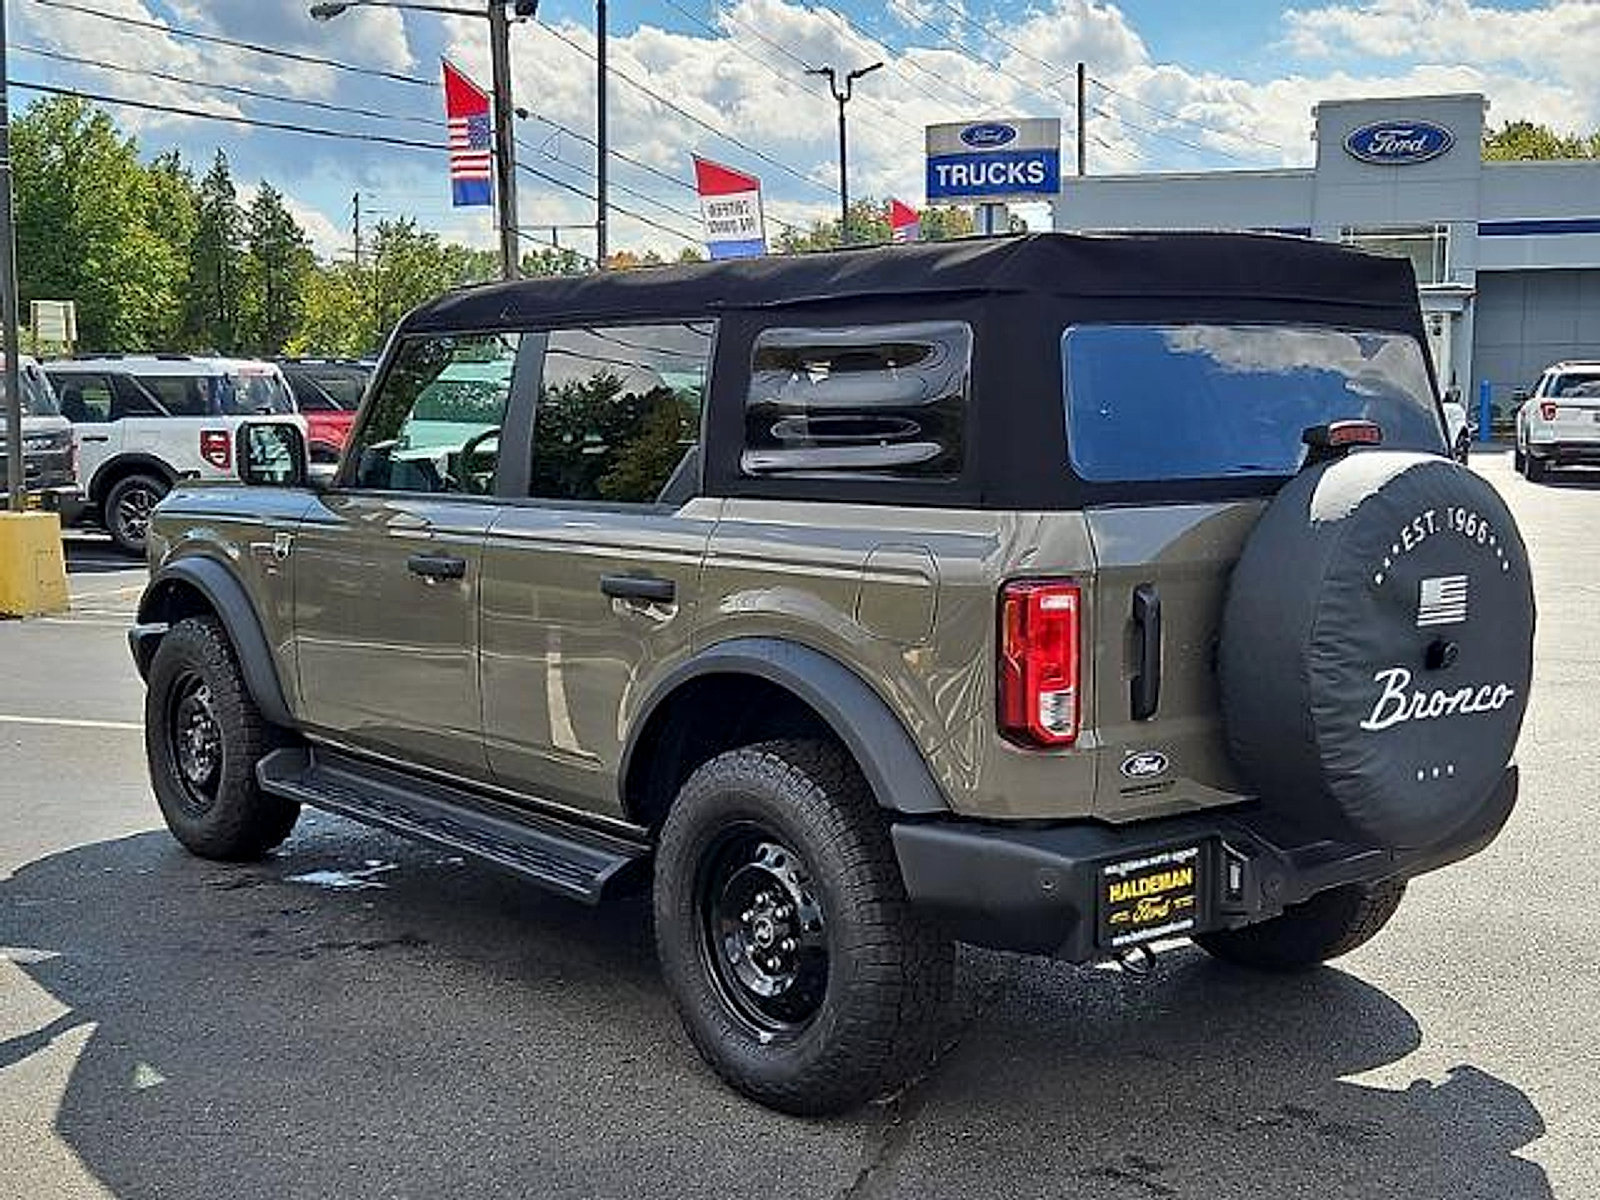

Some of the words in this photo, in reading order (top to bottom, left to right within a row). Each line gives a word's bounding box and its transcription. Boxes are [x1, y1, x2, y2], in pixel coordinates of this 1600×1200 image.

[1367, 130, 1429, 153] Ford
[935, 160, 1044, 187] TRUCKS
[1401, 509, 1441, 551] EST.
[1447, 507, 1489, 544] 1966
[1359, 667, 1515, 731] Bronco
[1109, 867, 1193, 903] HALDEMAN
